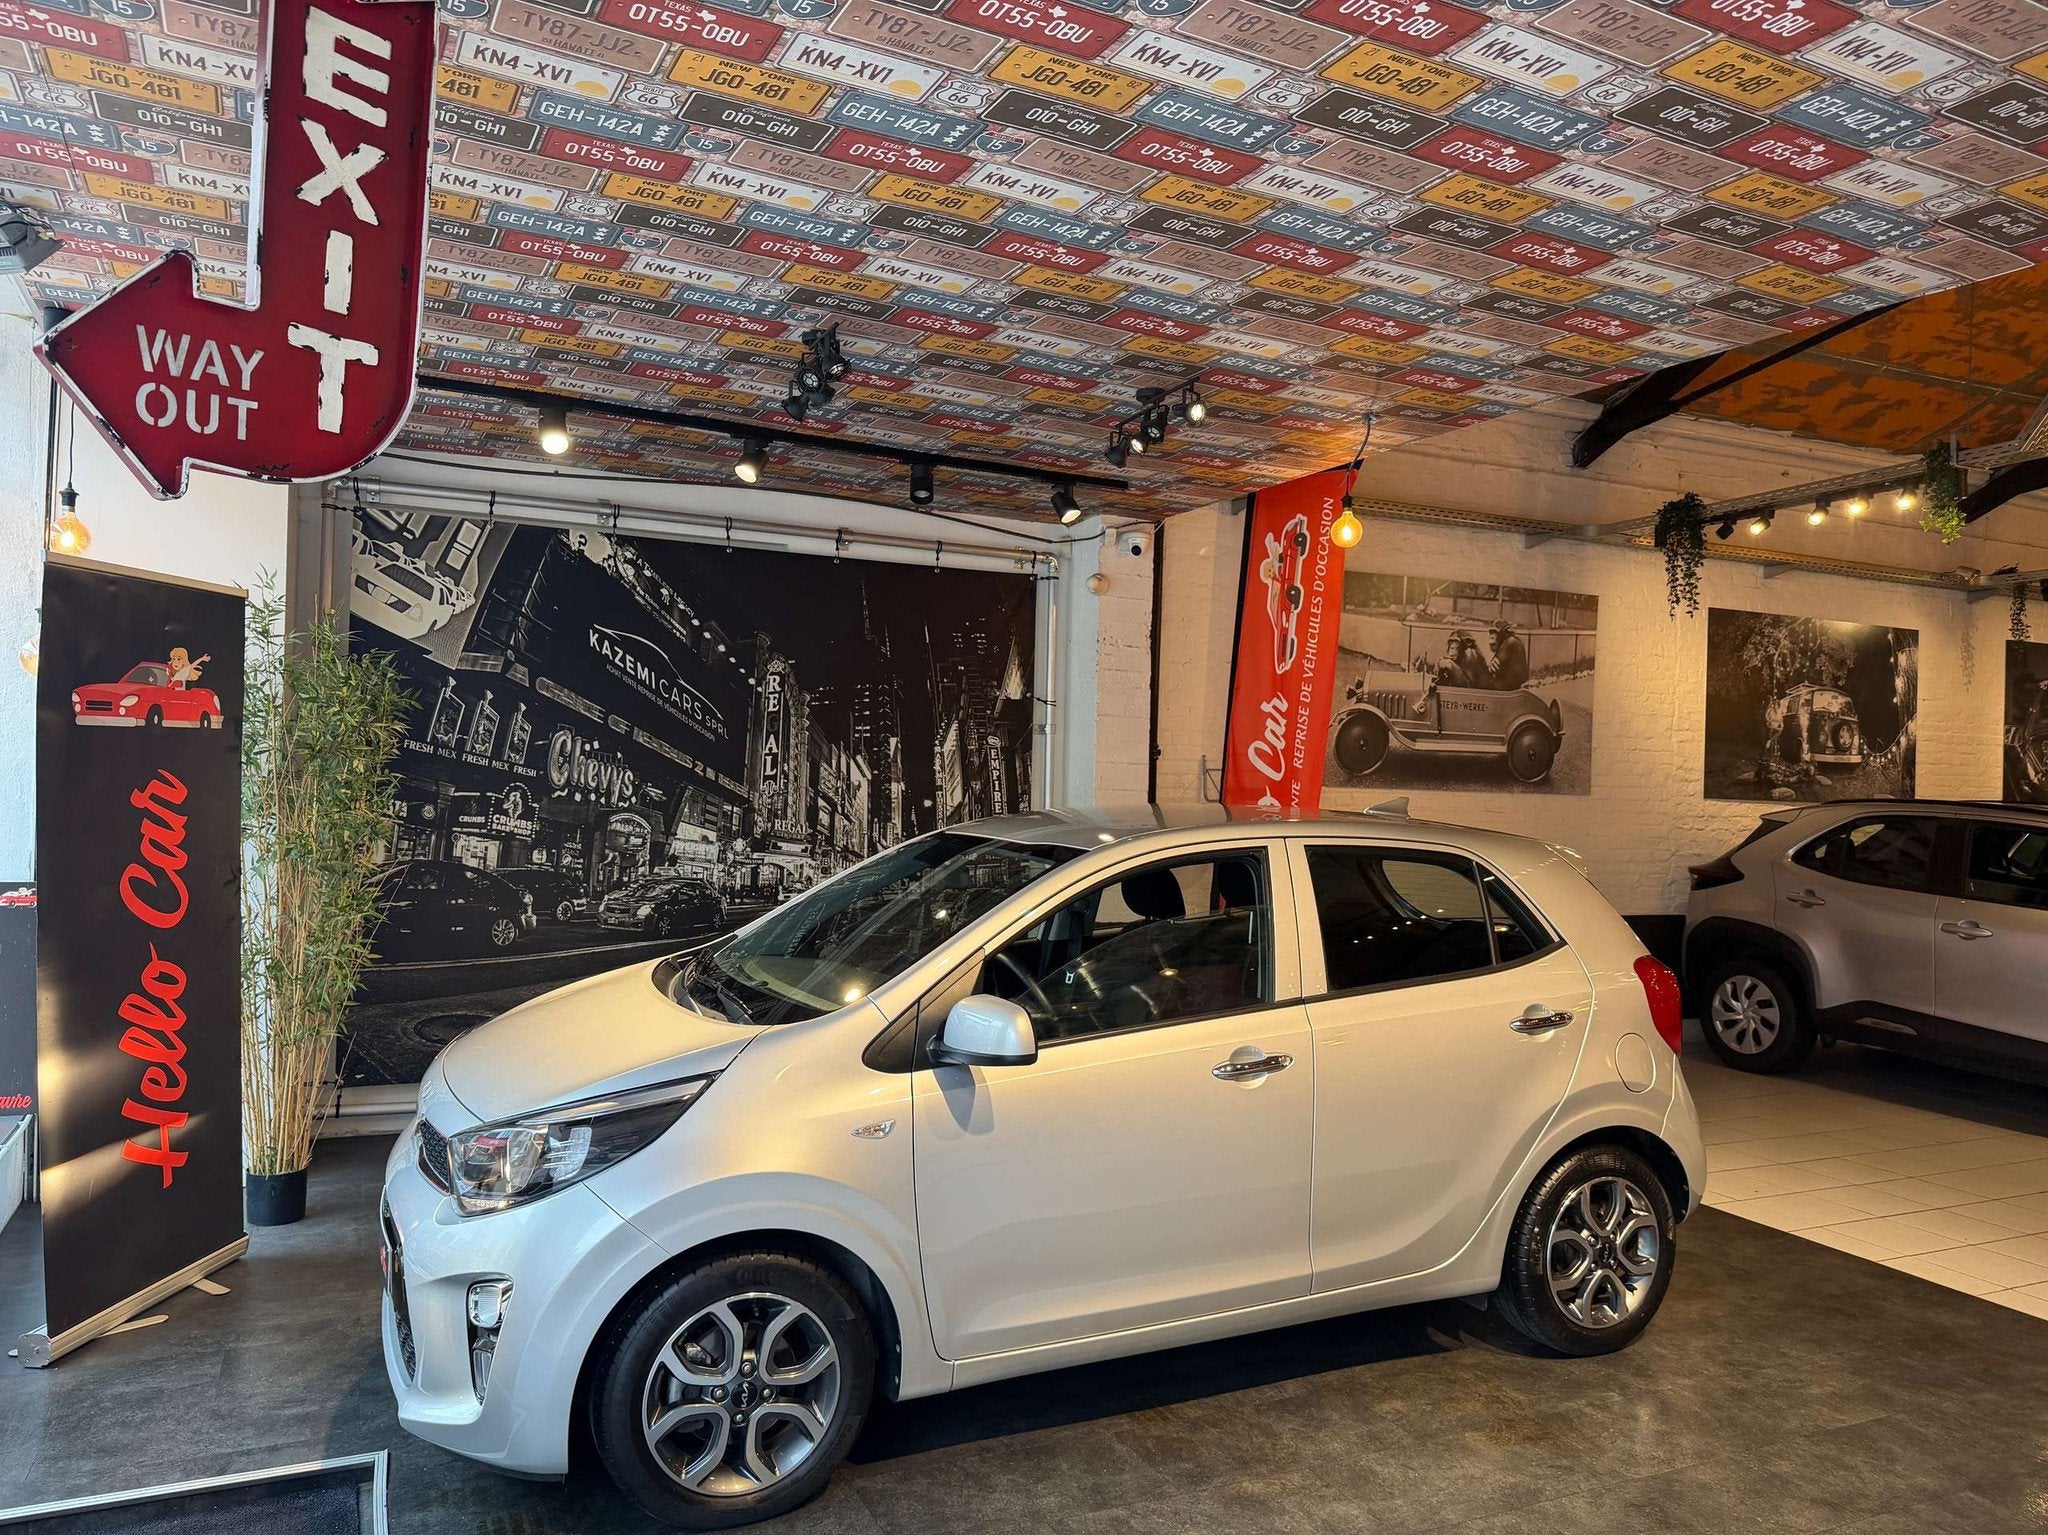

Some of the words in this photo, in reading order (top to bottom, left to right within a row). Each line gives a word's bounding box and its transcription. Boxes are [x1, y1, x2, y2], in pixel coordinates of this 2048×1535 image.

[664, 0, 692, 13] TEXAS
[523, 11, 635, 55] TY87-JJ2
[864, 8, 971, 53] TY87-JJ2
[1216, 4, 1317, 50] TY87-JJ2
[1579, 2, 1675, 49] TY87-JJ2
[473, 46, 572, 82] KN4-XV1
[797, 46, 893, 83] KN4-XV1
[1047, 57, 1080, 69] NEW
[1084, 66, 1120, 81] YORK
[1130, 43, 1224, 81] KN4-XV1
[1386, 55, 1418, 67] NEW
[1420, 64, 1454, 80] YORK
[1474, 38, 1566, 77] KN4-XV1
[1735, 53, 1766, 65] NEW
[1764, 63, 1797, 78] YORK
[1827, 35, 1917, 74] KN4-XV1
[90, 60, 127, 72] NEW
[134, 70, 179, 84] YORK
[718, 61, 752, 73] NEW
[759, 70, 795, 84] YORK
[638, 92, 659, 104] 66
[947, 91, 970, 104] 66
[1266, 90, 1291, 102] 66
[1594, 88, 1621, 101] 66
[540, 102, 642, 135] GEH-142A
[842, 102, 940, 135] GEH-142A
[1152, 100, 1247, 135] GEH-142A
[1471, 98, 1564, 133] GEH-142A
[1799, 95, 1888, 131] GEH-142A
[592, 140, 615, 148] TEXAS
[696, 138, 714, 149] 15
[880, 141, 903, 150] TEXAS
[986, 138, 1006, 150] 15
[1176, 141, 1198, 150] TEXAS
[1283, 138, 1306, 149] 15
[1589, 136, 1615, 148] 15
[287, 5, 392, 433] EXIT
[497, 211, 583, 235] GEH-142A
[749, 211, 833, 236] GEH-142A
[1007, 213, 1089, 237] GEH-142A
[1271, 213, 1350, 238] GEH-142A
[1541, 212, 1619, 237] GEH-142A
[135, 324, 265, 391] WAY
[135, 382, 259, 440] OUT
[1313, 497, 1334, 593] D'OCCASION
[1303, 596, 1323, 678] VÉHICULES
[589, 629, 656, 689] KAZEMI
[659, 679, 702, 720] CARS
[705, 715, 729, 740] SPRL
[1300, 681, 1313, 704] DE
[764, 674, 782, 776] REGAL
[1247, 691, 1289, 781] Car
[1293, 705, 1310, 769] REPRISE
[403, 739, 434, 755] FRESH
[437, 747, 457, 760] MEX
[462, 753, 489, 767] FRESH
[492, 760, 510, 772] MEX
[513, 766, 537, 778] FRESH
[548, 729, 634, 807] Chevys
[990, 748, 1003, 813] EMPIRE
[459, 815, 486, 823] CRUMBS
[492, 814, 533, 830] CRUMBS
[774, 819, 808, 834] REGAL
[119, 768, 188, 929] Car
[119, 941, 190, 1189] Hello
